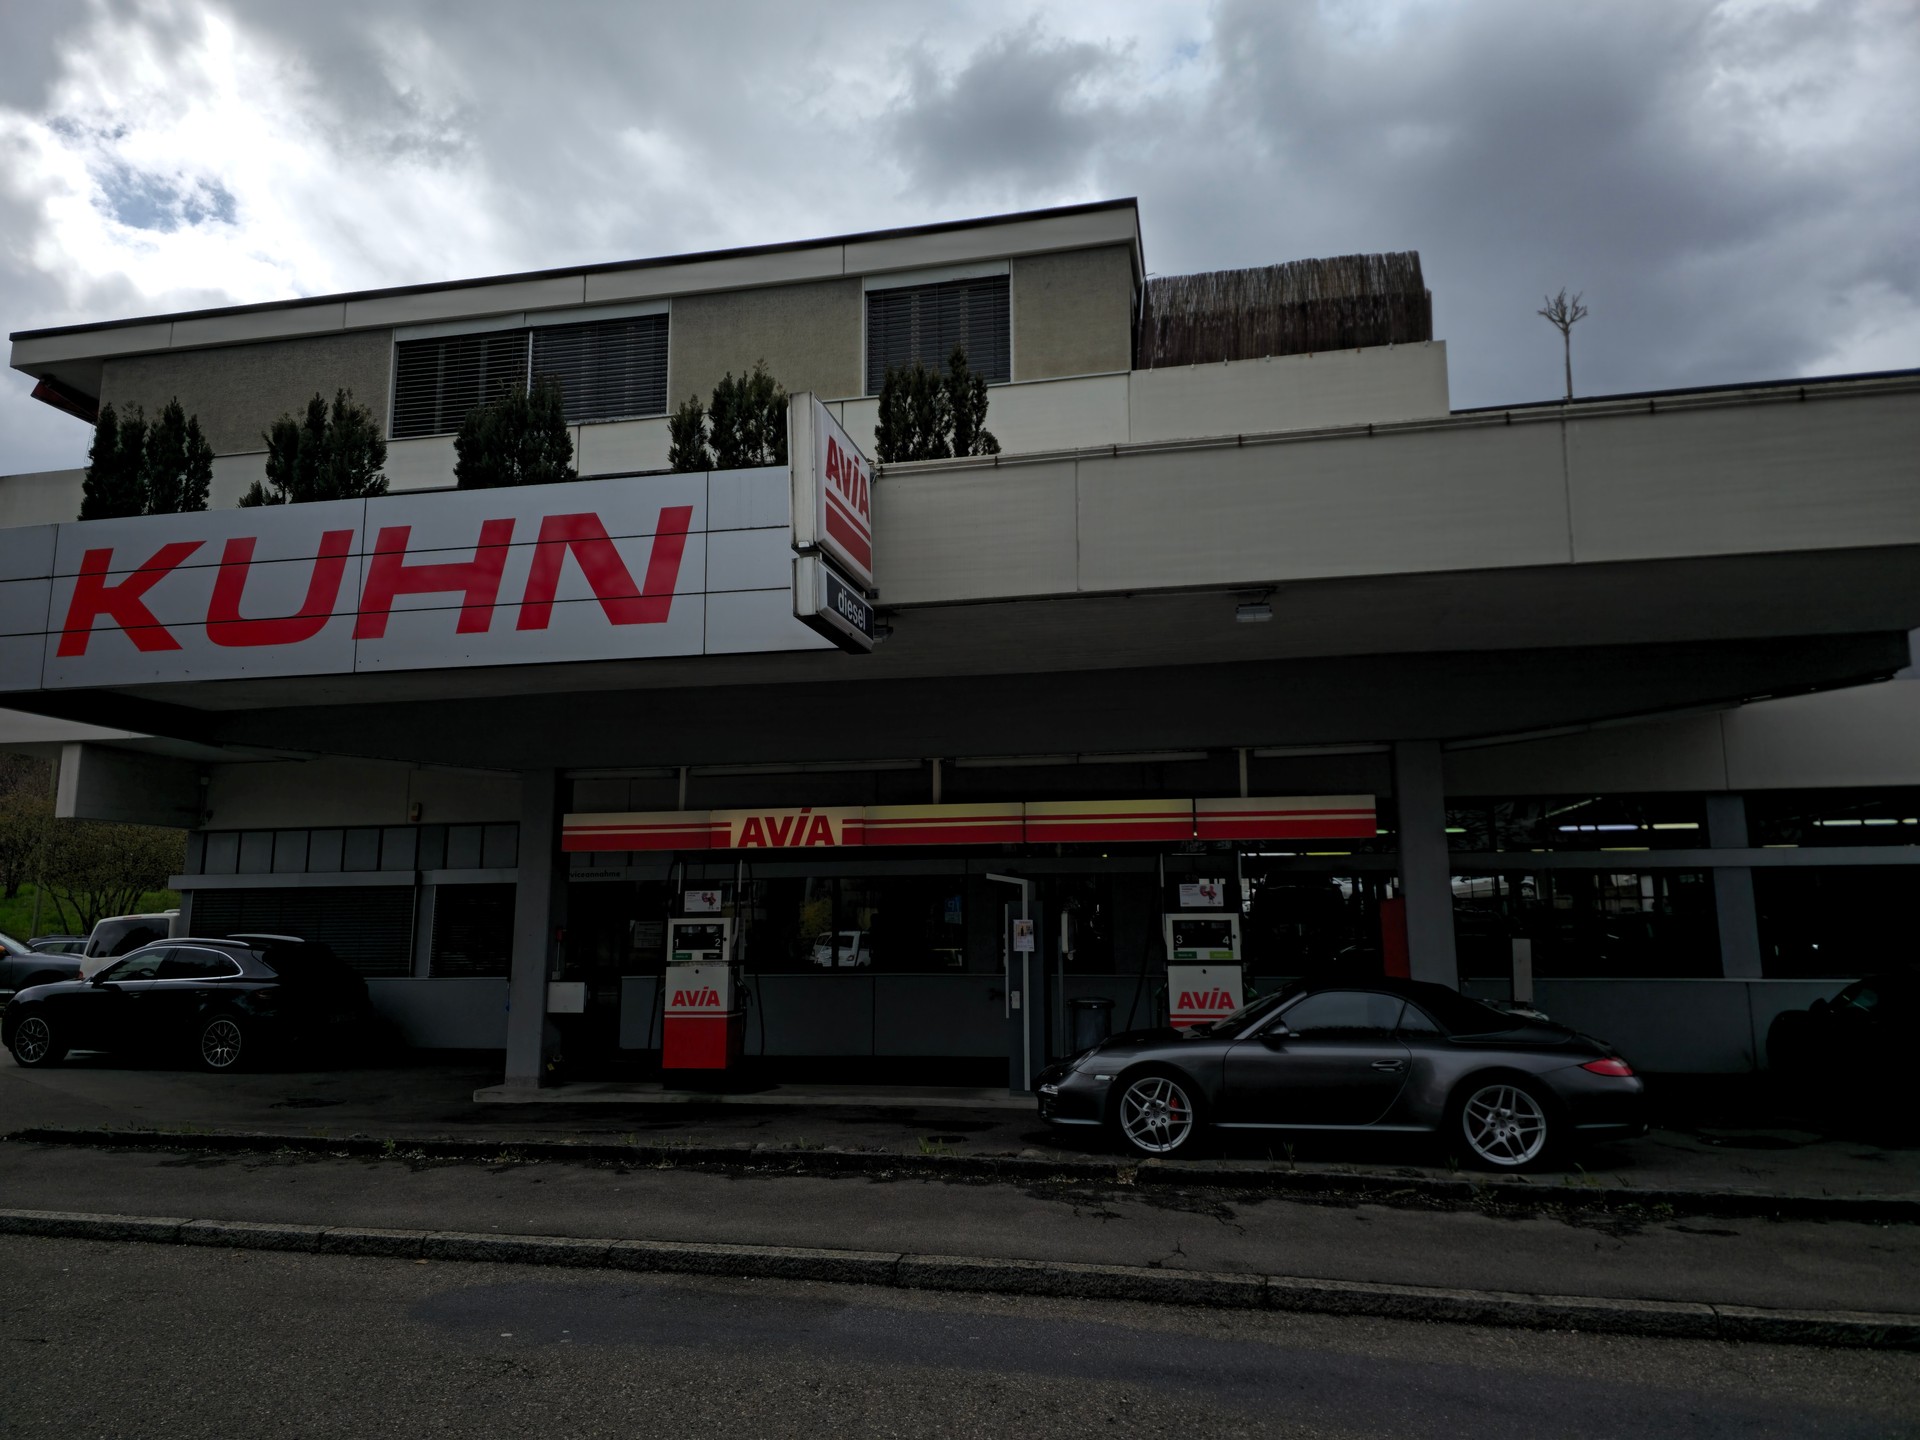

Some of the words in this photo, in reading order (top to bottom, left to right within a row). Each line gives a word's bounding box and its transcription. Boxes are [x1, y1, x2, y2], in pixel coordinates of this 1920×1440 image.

[56, 505, 693, 657] KUHN
[838, 589, 866, 631] diesel
[674, 938, 679, 949] 1
[714, 938, 721, 949] 2
[1176, 934, 1183, 945] 3
[1222, 936, 1230, 946] 4
